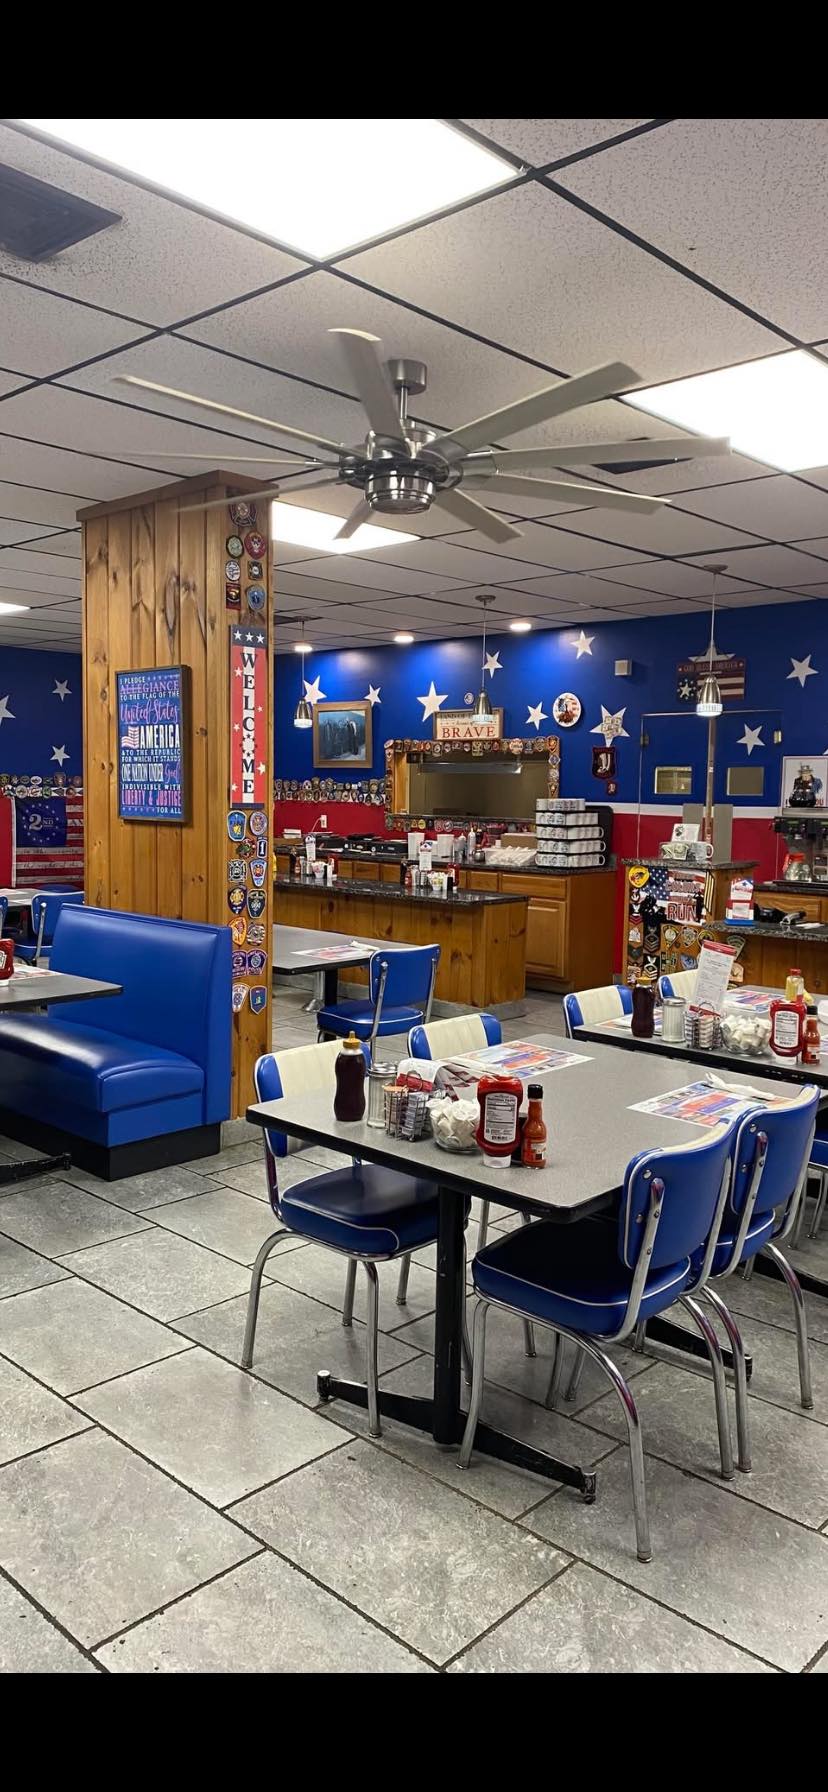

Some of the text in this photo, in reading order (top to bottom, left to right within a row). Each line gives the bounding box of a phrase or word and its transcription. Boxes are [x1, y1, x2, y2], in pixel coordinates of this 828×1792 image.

[120, 680, 179, 694] ALLEGIANCE
[124, 676, 145, 684] PLEDGE
[120, 699, 179, 724] United States
[140, 724, 180, 749] AMERICA
[442, 726, 496, 738] BRAVE
[150, 748, 181, 756] REPUBLIC
[121, 763, 131, 782] ONE
[132, 763, 148, 781] NATION
[149, 763, 164, 781] UNDER
[121, 790, 145, 805] LIBERTY
[156, 790, 181, 807] JUSTICE
[667, 902, 698, 921] RUN
